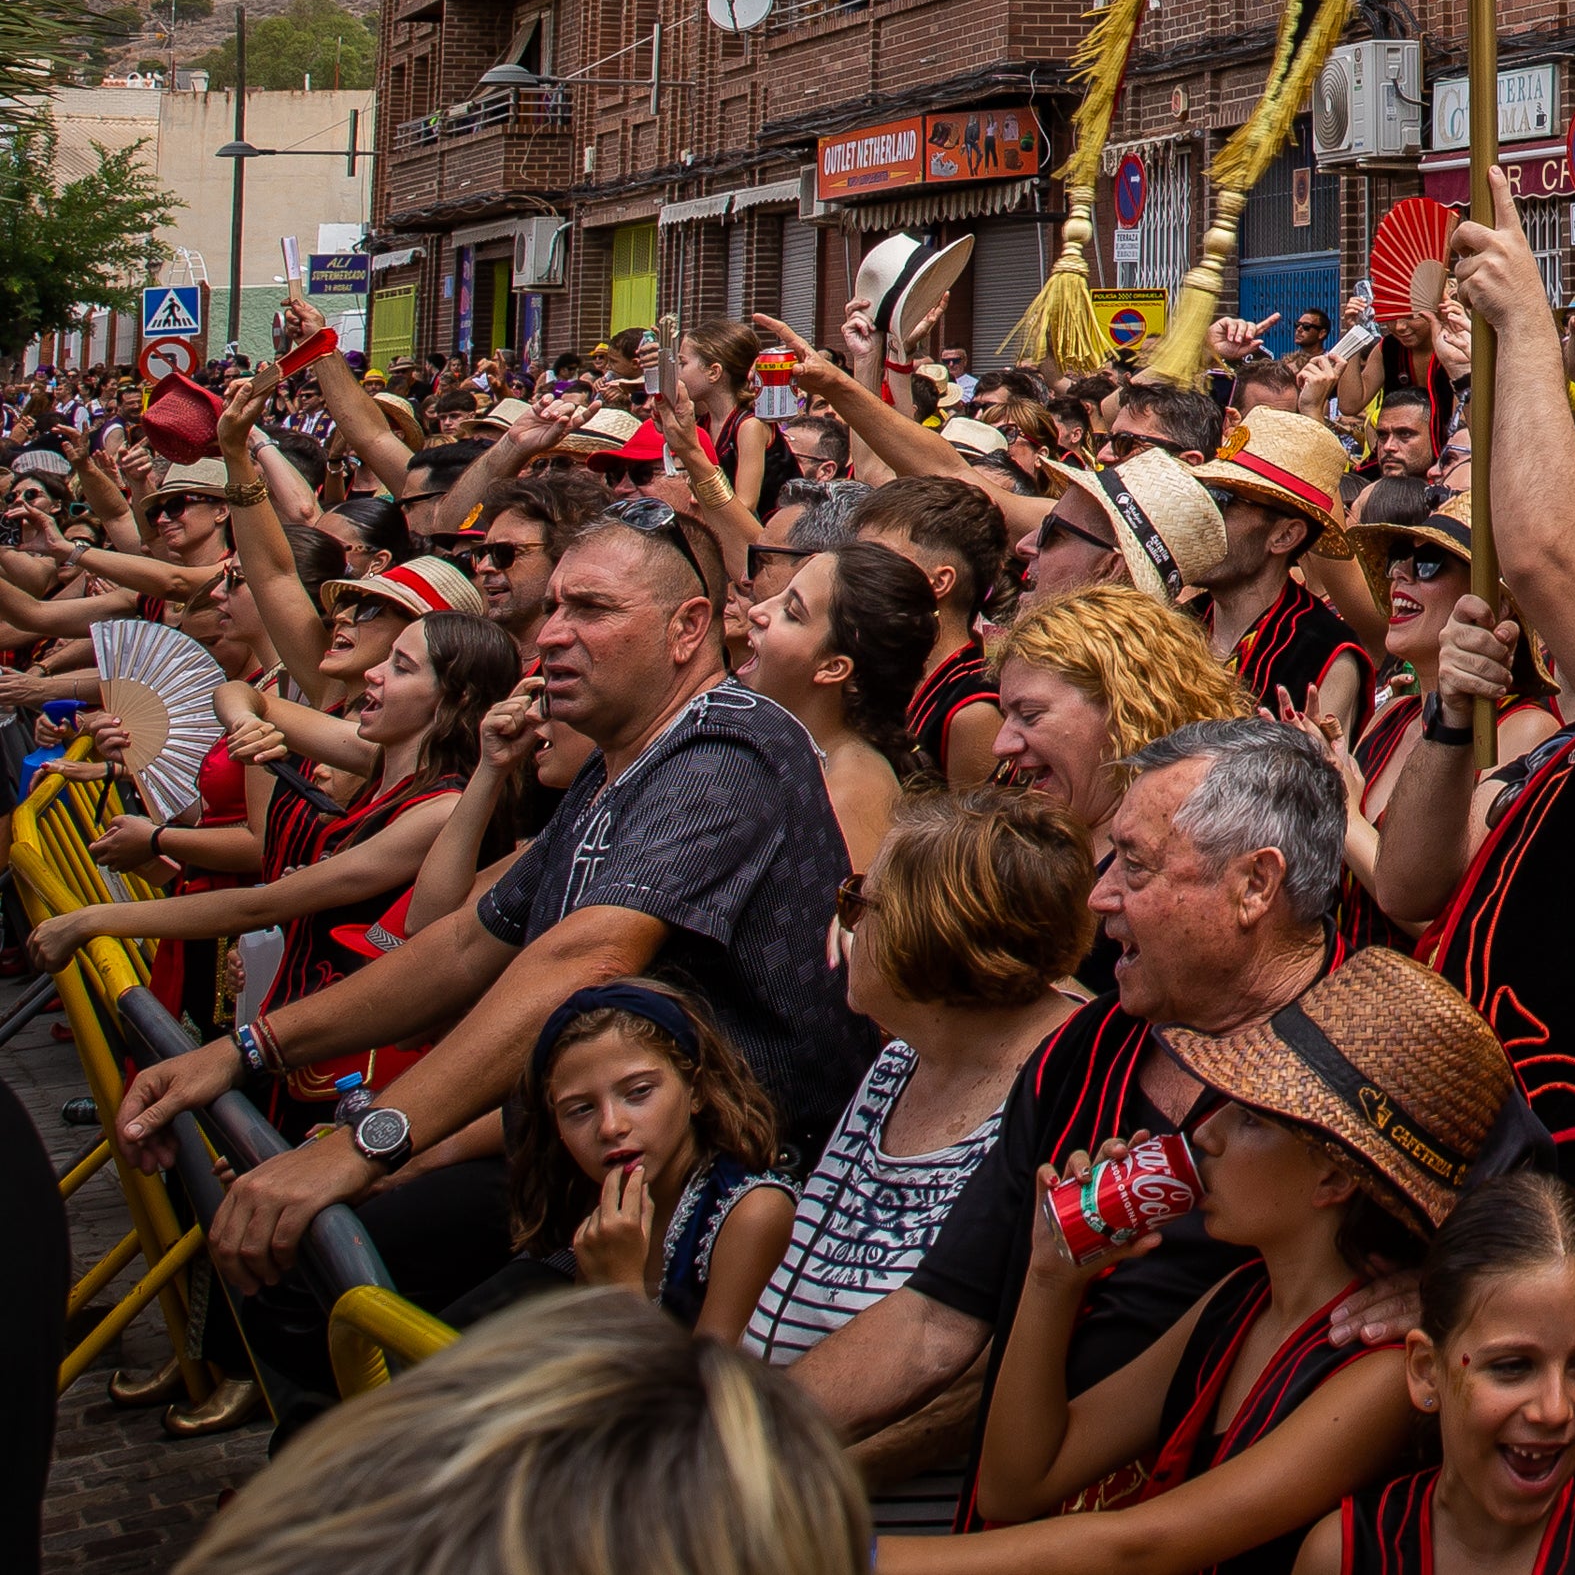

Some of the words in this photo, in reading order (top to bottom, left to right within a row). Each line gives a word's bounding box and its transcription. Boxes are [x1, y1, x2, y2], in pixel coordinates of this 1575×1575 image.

[1437, 74, 1544, 144] CTERIA
[824, 142, 857, 176] OUTLET
[857, 129, 917, 168] NETHERLAND
[1117, 234, 1138, 242] TERRAZA
[326, 257, 352, 269] ALI
[1133, 292, 1163, 300] ORIHUELA
[1145, 541, 1163, 565] Galicia
[1391, 1124, 1454, 1178] CAFETERIA
[1116, 1182, 1141, 1229] ORIGINAL
